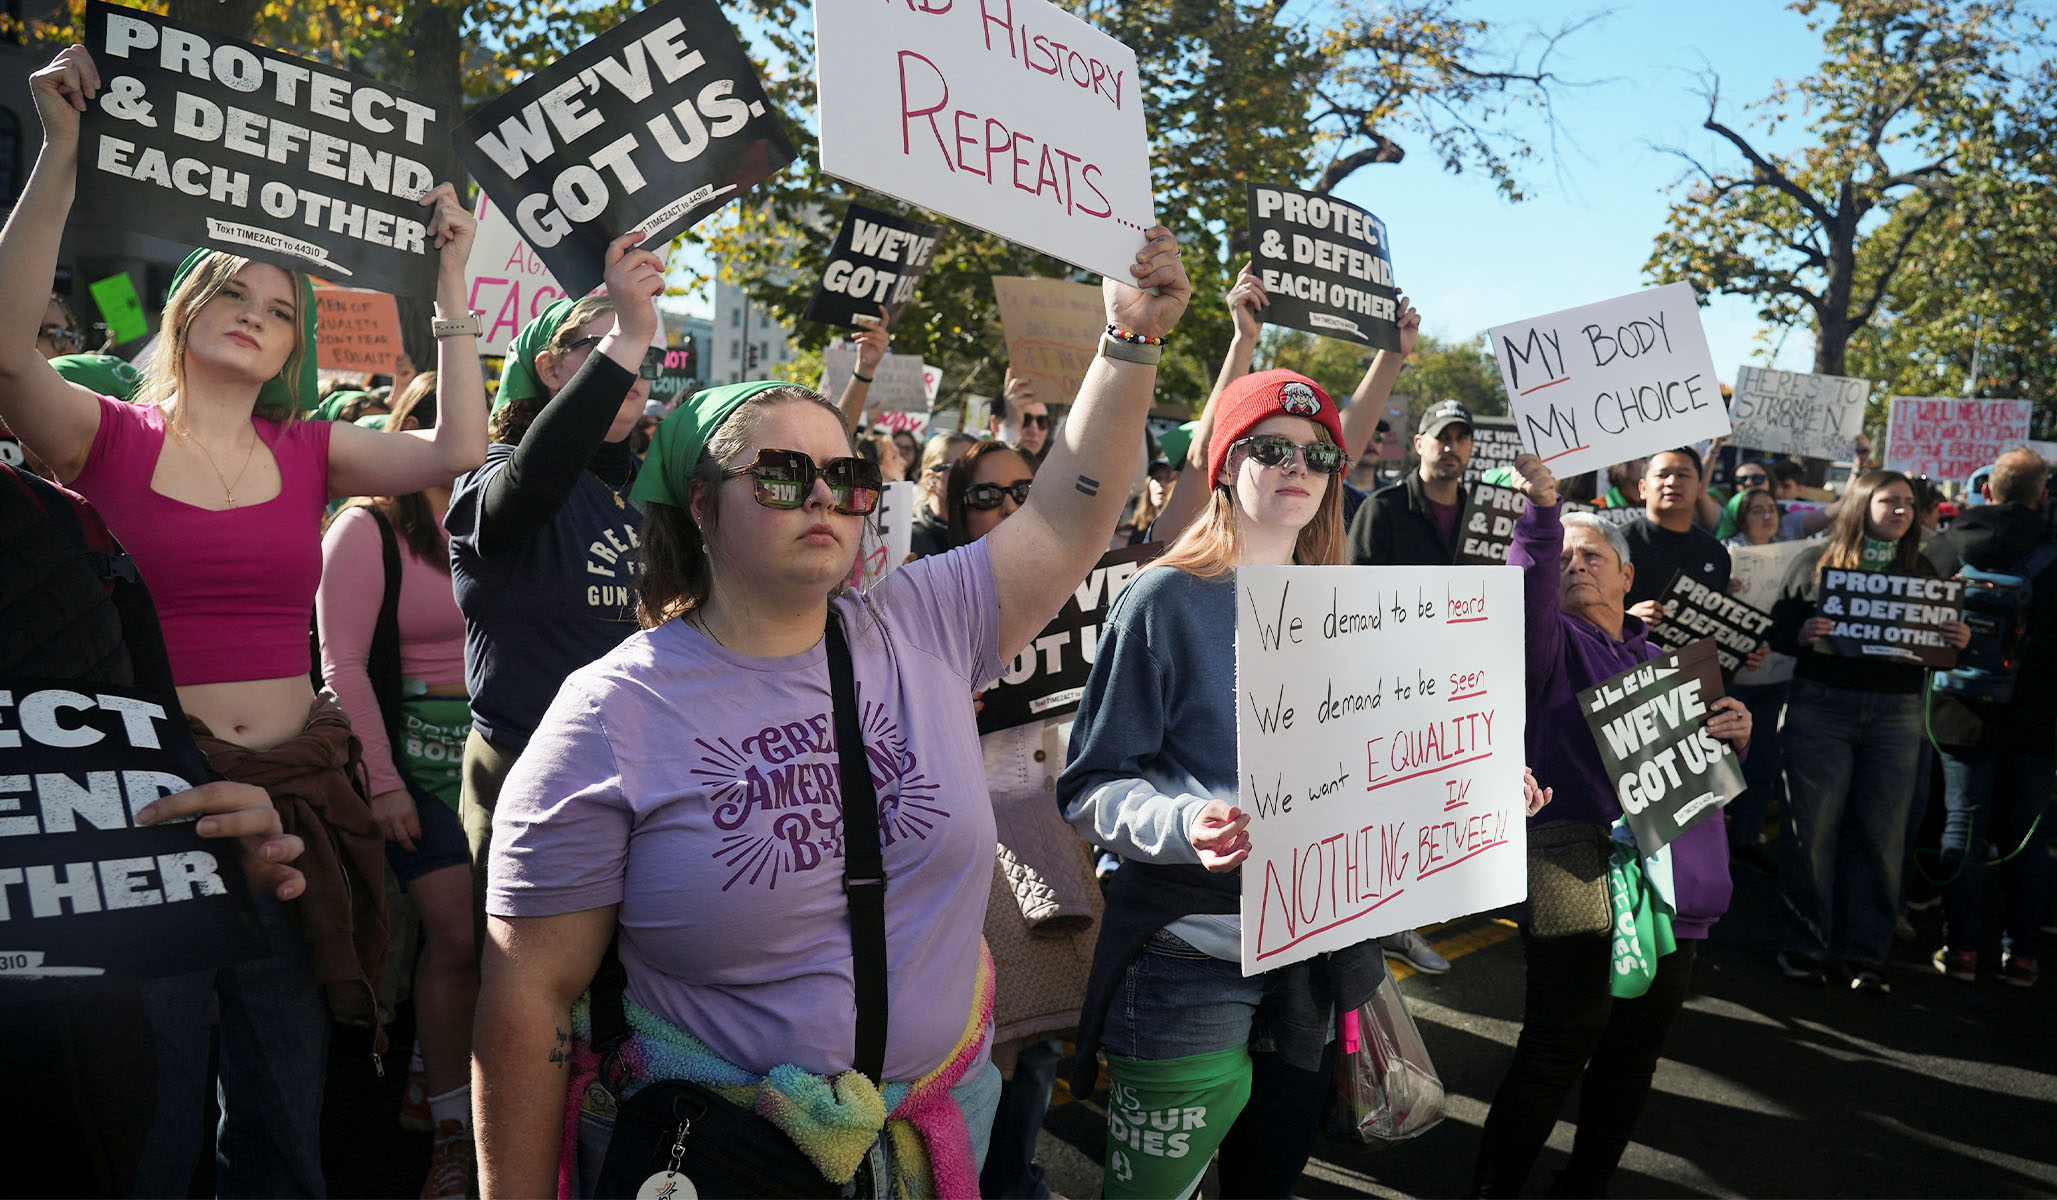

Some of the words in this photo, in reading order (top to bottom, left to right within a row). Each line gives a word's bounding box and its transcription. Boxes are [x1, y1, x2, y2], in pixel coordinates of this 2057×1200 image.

[105, 12, 436, 145] PROTECT
[980, 0, 1124, 111] HISTORY
[474, 17, 706, 180] WE'VE
[100, 75, 158, 128] &
[173, 90, 434, 202] DEFEND
[516, 132, 647, 248] GOT
[646, 78, 767, 163] US.
[97, 134, 251, 208] EACH
[260, 181, 426, 255] OTHER
[646, 204, 681, 230] TIME2ACT
[681, 202, 690, 210] to
[689, 188, 709, 204] 44310
[1256, 188, 1387, 251] PROTECT
[215, 222, 235, 236] Text
[236, 227, 283, 247] TIME2ACT
[284, 241, 293, 251] to
[294, 244, 320, 257] 44310
[850, 218, 936, 268] WE'VE
[1259, 228, 1287, 260] &
[1292, 233, 1393, 288] DEFEND
[822, 259, 897, 303] GOT
[1262, 269, 1326, 304] EACH
[1330, 284, 1396, 323] OTHER
[1503, 328, 1564, 390] MY
[1582, 311, 1672, 367] BODY
[1525, 403, 1580, 460] MY
[1594, 374, 1709, 435] CHOICE
[1834, 379, 1862, 405] TO
[1468, 511, 1488, 535] &
[587, 584, 628, 606] GUN
[1246, 580, 1303, 651] We
[1323, 586, 1382, 639] demand
[1391, 590, 1407, 623] to
[1418, 585, 1436, 619] be
[1447, 580, 1486, 619] heard
[1672, 574, 1774, 635] PROTECT
[1822, 595, 1845, 616] &
[1850, 598, 1958, 625] DEFEND
[1826, 569, 1962, 602] PROTECT
[1653, 622, 1692, 643] ACH
[1663, 598, 1681, 619] &
[1676, 608, 1757, 653] DEFEND
[979, 631, 1070, 693] OT
[1249, 684, 1295, 735] We
[1318, 676, 1382, 724] demand
[1394, 676, 1411, 701] to
[1419, 668, 1436, 696] be
[1449, 669, 1485, 695] seen
[1601, 678, 1707, 761] WE'VE
[1250, 772, 1293, 820] We
[1308, 762, 1350, 802] want
[1367, 709, 1495, 783] EQUALITY
[1446, 778, 1472, 806] IN
[1618, 746, 1683, 815] GOT
[1677, 726, 1732, 775] US.
[1257, 822, 1410, 954] NOTHING
[1418, 808, 1508, 874] BETWEEN
